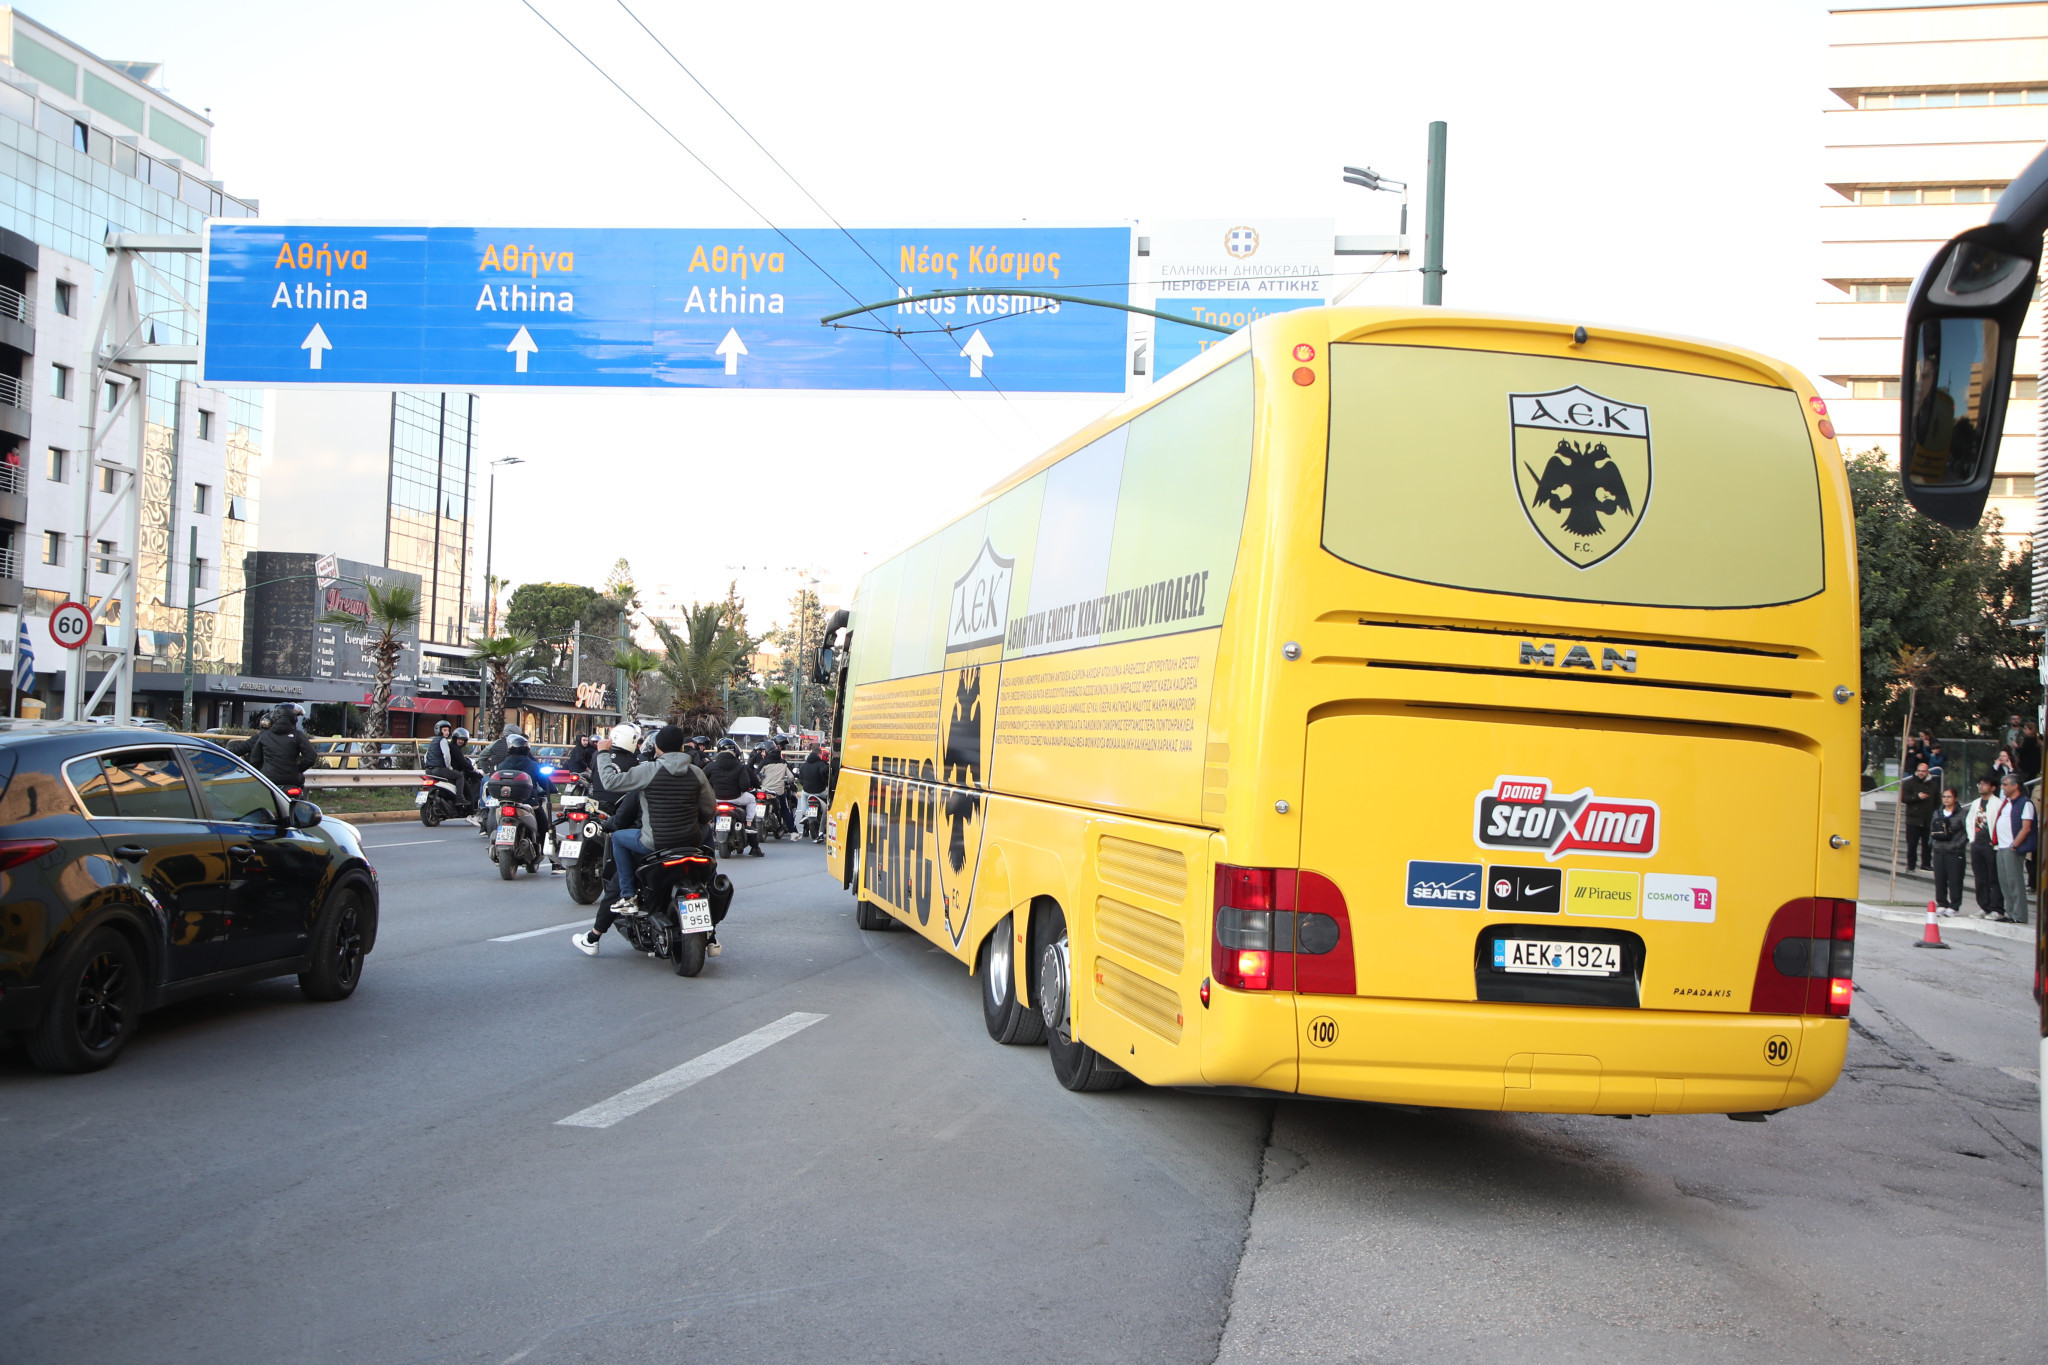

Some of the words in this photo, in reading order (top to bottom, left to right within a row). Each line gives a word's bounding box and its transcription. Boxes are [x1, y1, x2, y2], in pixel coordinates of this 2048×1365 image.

[275, 242, 368, 276] Αθήνα
[479, 243, 574, 278] Αθήνα
[688, 245, 785, 280] Αθήνα
[900, 244, 958, 280] Νέος
[968, 244, 1061, 281] Κόσμος
[1161, 265, 1228, 276] ΕΛΛΗΝΙΚΗ
[1233, 265, 1321, 276] ΔΗΜΟΚΡΑΤΙΑ
[271, 281, 368, 310] Athina
[1162, 280, 1251, 292] ΠΕΡΙΦΕΡΕΙΑ
[1258, 280, 1320, 292] ΑΤΤΙΚΗΣ
[476, 284, 574, 313] Athina
[684, 286, 785, 314] Athina
[898, 286, 956, 315] Neos
[966, 287, 1061, 315] Kosmos
[1573, 542, 1594, 553] F.C.
[1006, 615, 1046, 651] ΑΘΛΗΤΙΚΗ
[1046, 601, 1076, 644] ΕΝΩΣΙΣ
[1076, 570, 1210, 637] ΚΩΝΣΤΑΝΤΙΝΟΥΠΟΛΕΩΣ
[58, 616, 84, 635] 60
[344, 630, 381, 651] Everythin
[361, 651, 379, 668] righ
[1519, 641, 1637, 673] MAN
[270, 683, 288, 694] GRAND
[287, 685, 304, 695] HOTEL
[575, 682, 607, 710] Pilot
[1500, 783, 1543, 801] pame
[1412, 887, 1476, 901] SEAJETS
[1588, 886, 1632, 901] Piraeus
[1647, 892, 1690, 902] COSMOTE
[690, 914, 710, 926] 956
[1673, 987, 1732, 997] PAPADAKIS
[1313, 1021, 1335, 1043] 100
[1767, 1040, 1788, 1061] 90
